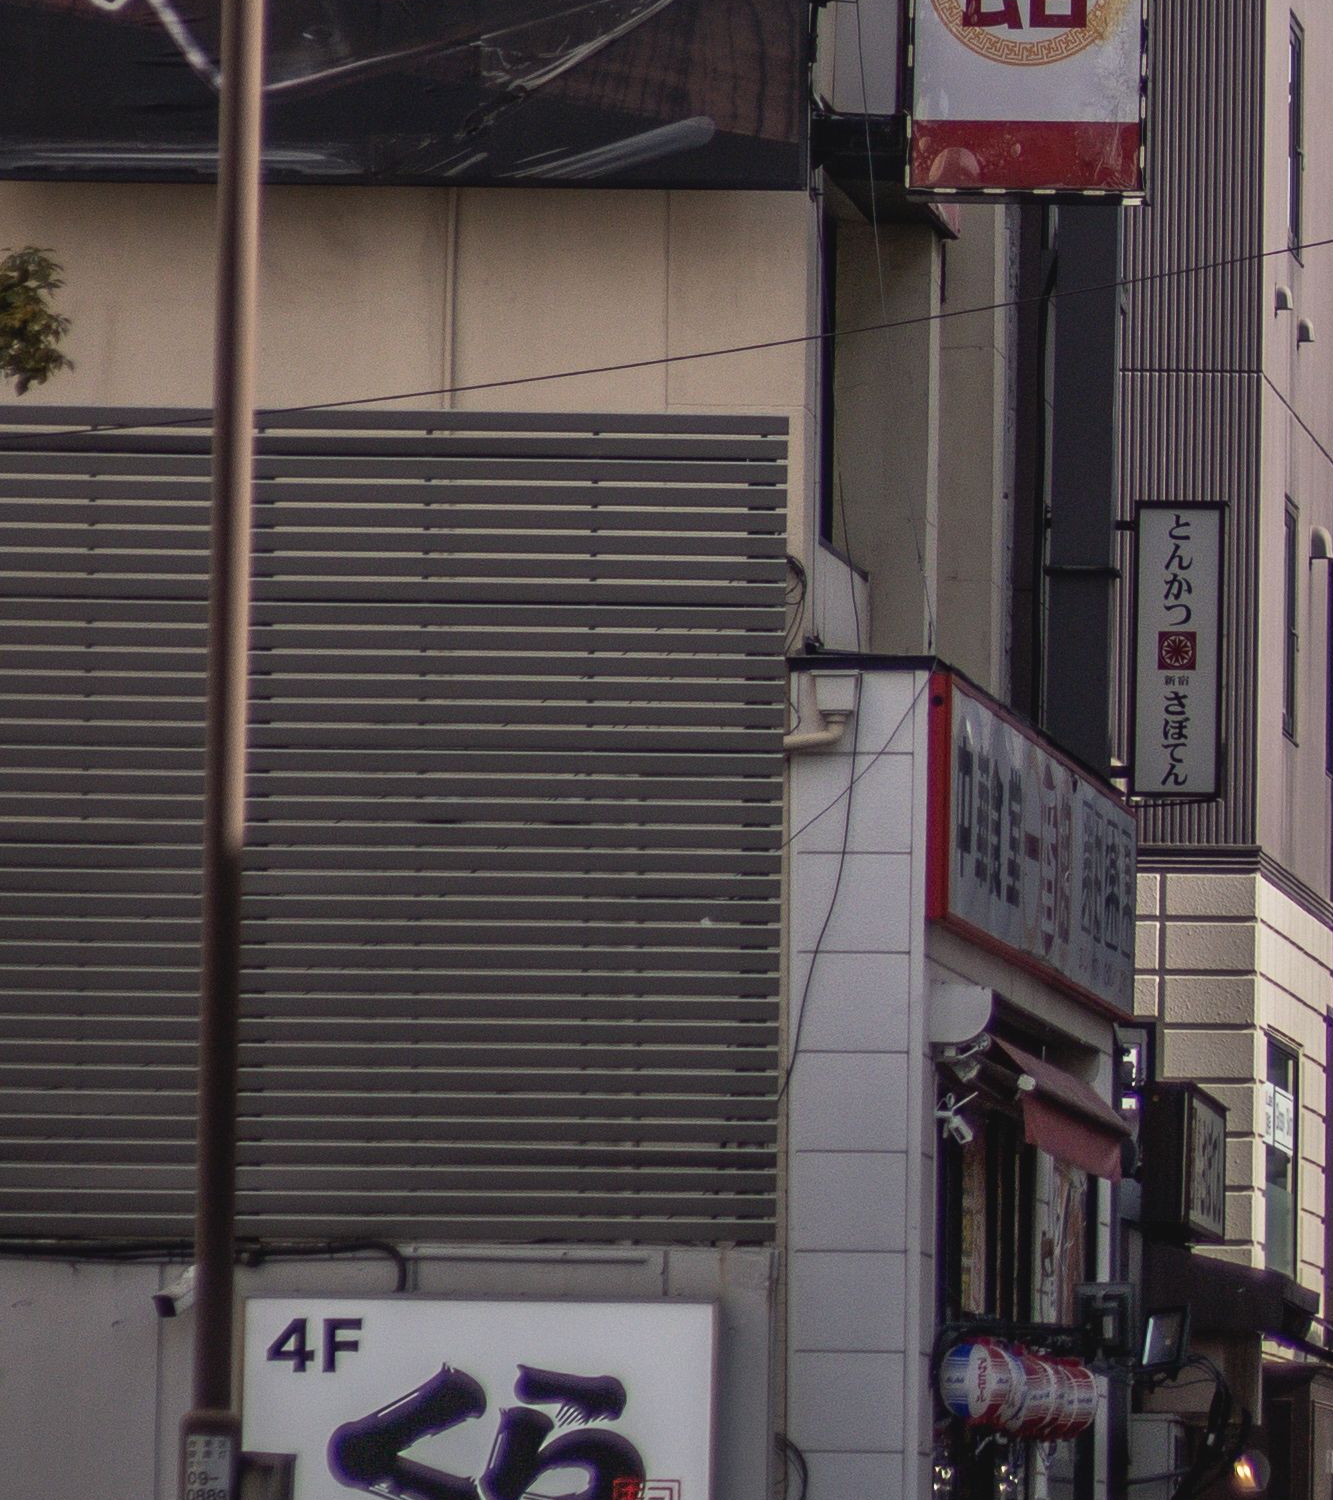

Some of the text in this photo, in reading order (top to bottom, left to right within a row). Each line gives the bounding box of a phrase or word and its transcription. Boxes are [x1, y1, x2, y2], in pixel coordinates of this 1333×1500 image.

[1163, 514, 1193, 626] とんかつ
[1165, 674, 1189, 686] 新宿
[1161, 691, 1188, 786] さぼてん
[265, 1317, 364, 1374] 4F
